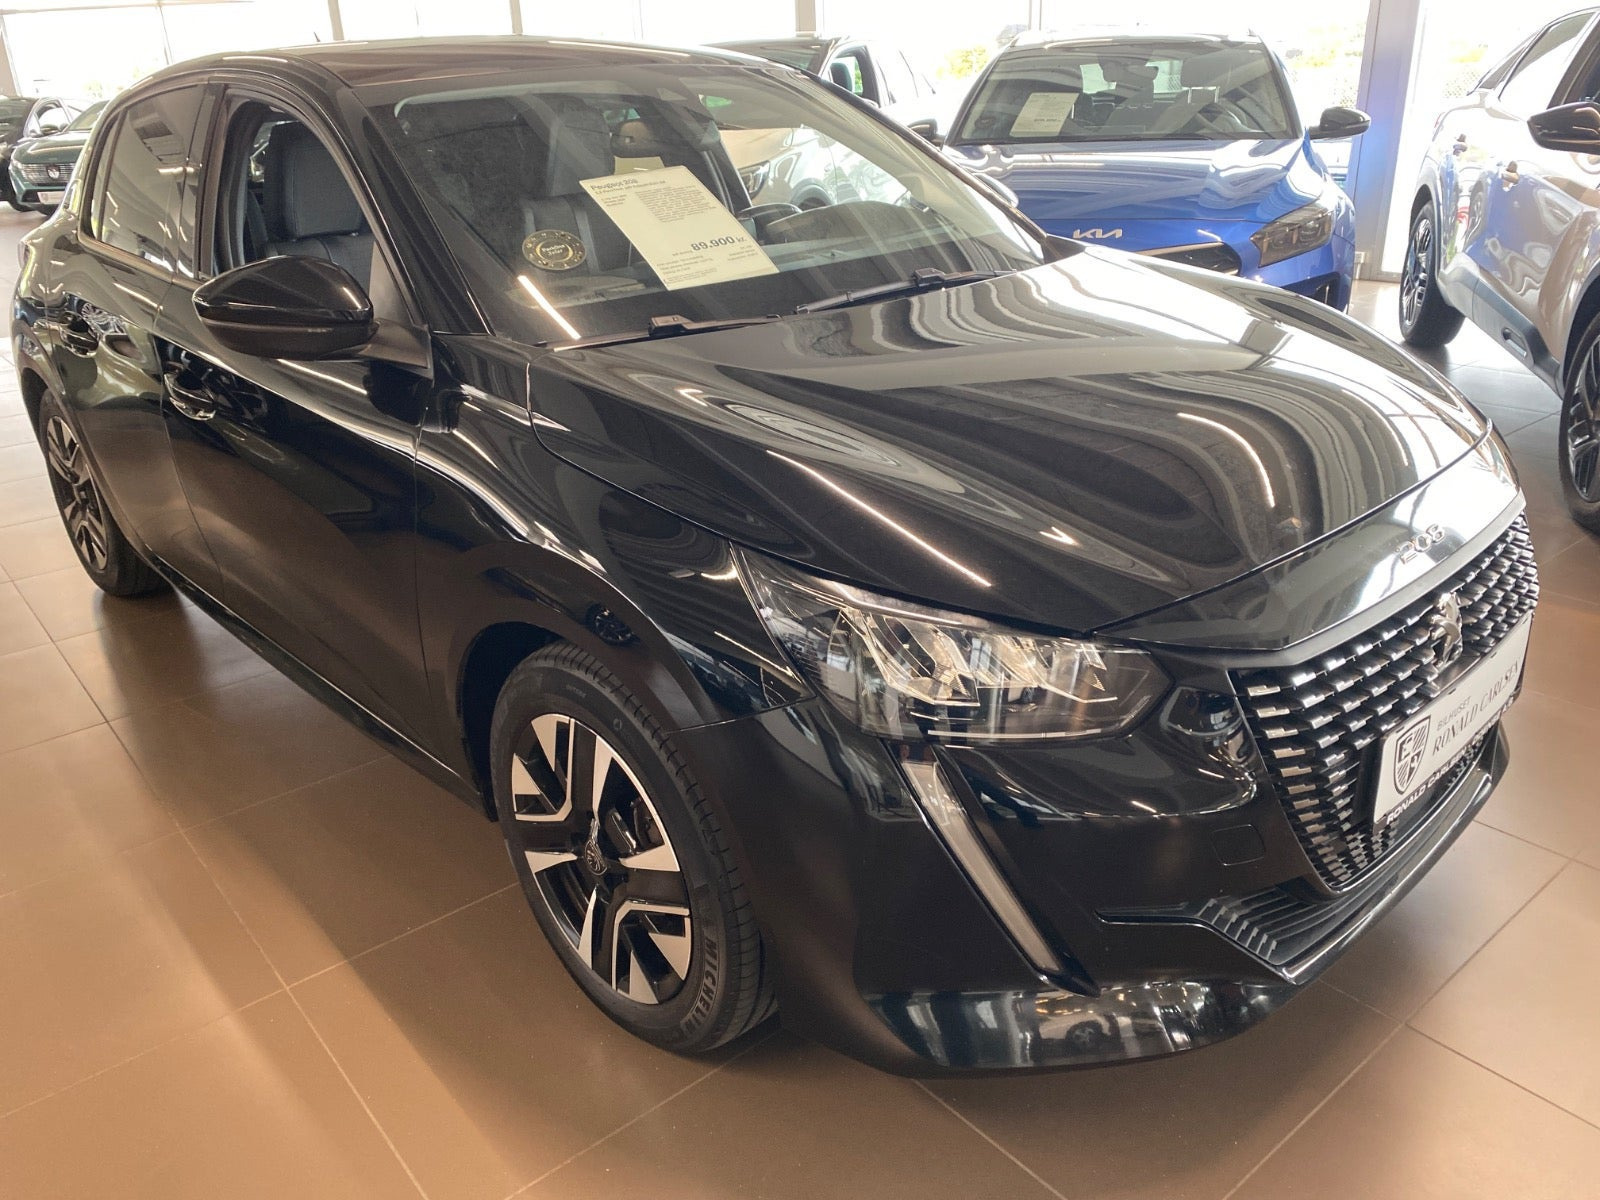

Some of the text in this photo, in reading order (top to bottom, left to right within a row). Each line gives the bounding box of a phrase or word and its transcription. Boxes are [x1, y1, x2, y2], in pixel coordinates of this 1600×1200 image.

[691, 236, 735, 251] 89.900
[1072, 228, 1123, 239] KIA
[1400, 524, 1445, 564] 208
[1433, 703, 1479, 755] RONALD
[1386, 784, 1426, 825] RONALD
[685, 937, 718, 1034] MICHELIN
